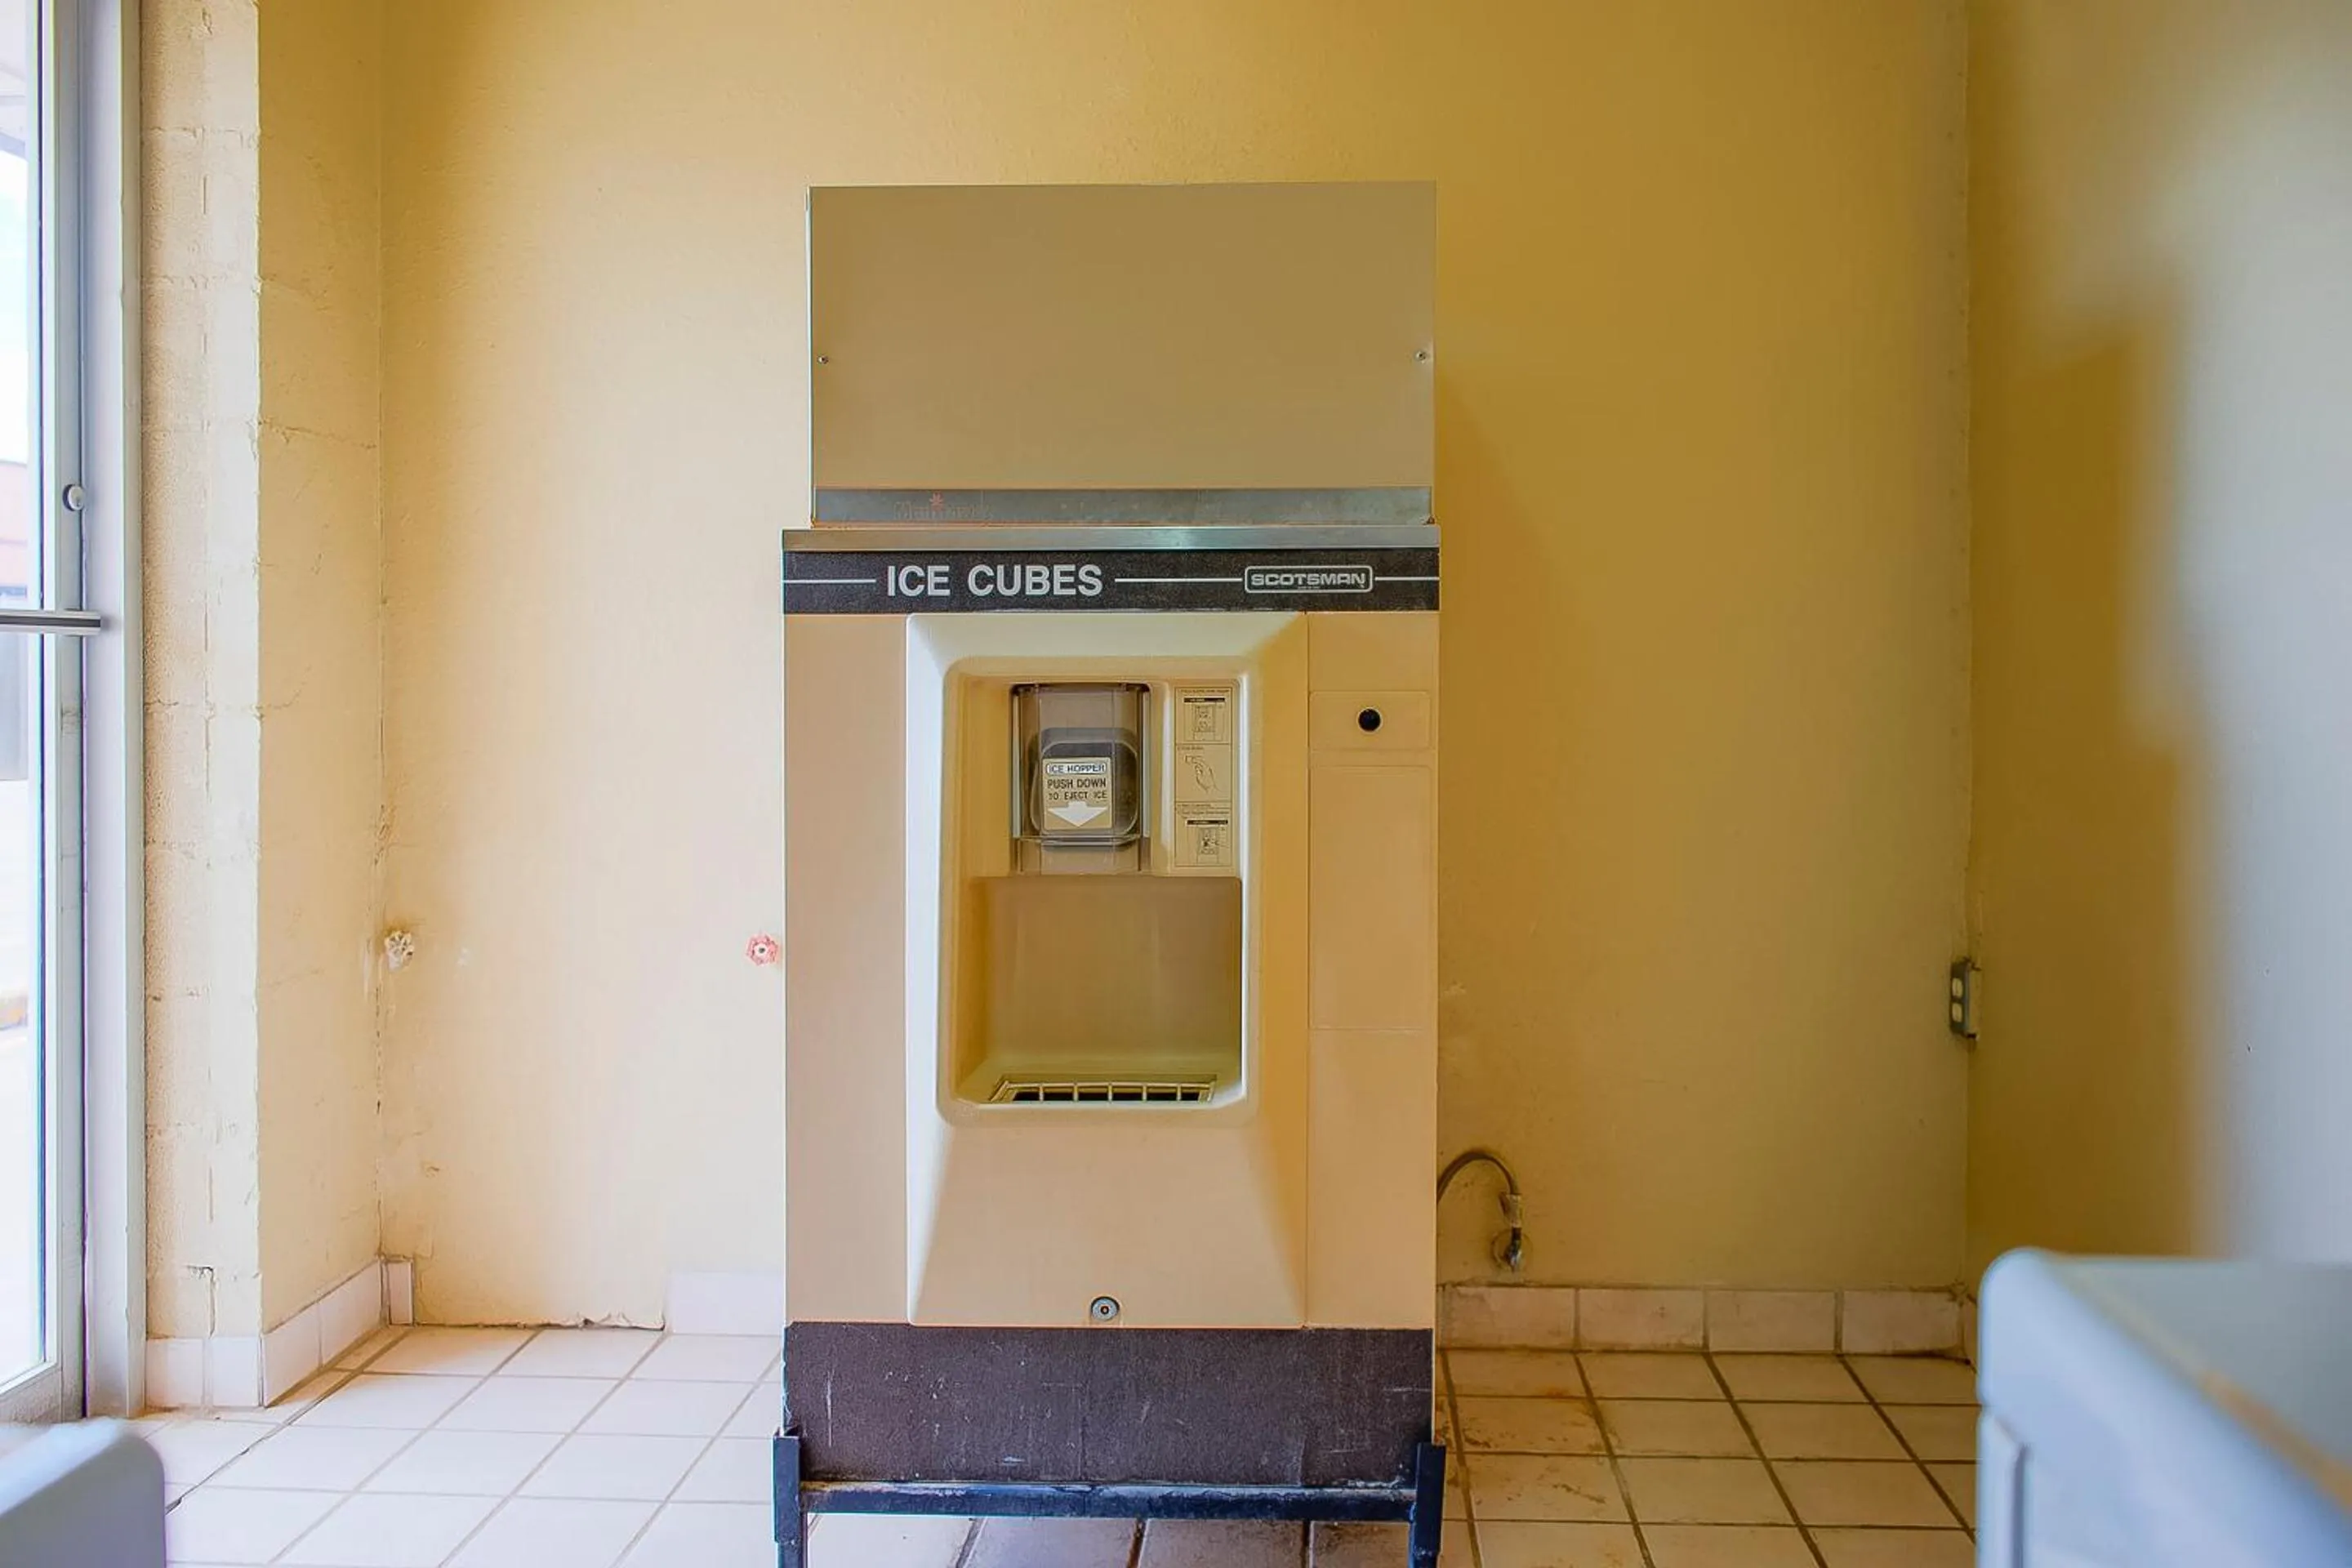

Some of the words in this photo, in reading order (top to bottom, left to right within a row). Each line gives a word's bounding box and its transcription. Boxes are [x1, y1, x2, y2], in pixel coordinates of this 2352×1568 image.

[887, 565, 951, 597] ICE
[967, 564, 1102, 597] CUBES
[1251, 573, 1366, 588] SCOTSMAN
[1049, 764, 1064, 773] ICE
[1067, 764, 1105, 773] HOPPER
[1047, 778, 1073, 789] PUSH
[1076, 777, 1107, 788] DOWN
[1048, 791, 1059, 800] TO
[1064, 791, 1089, 800] EJECT
[1093, 790, 1108, 799] ICE
